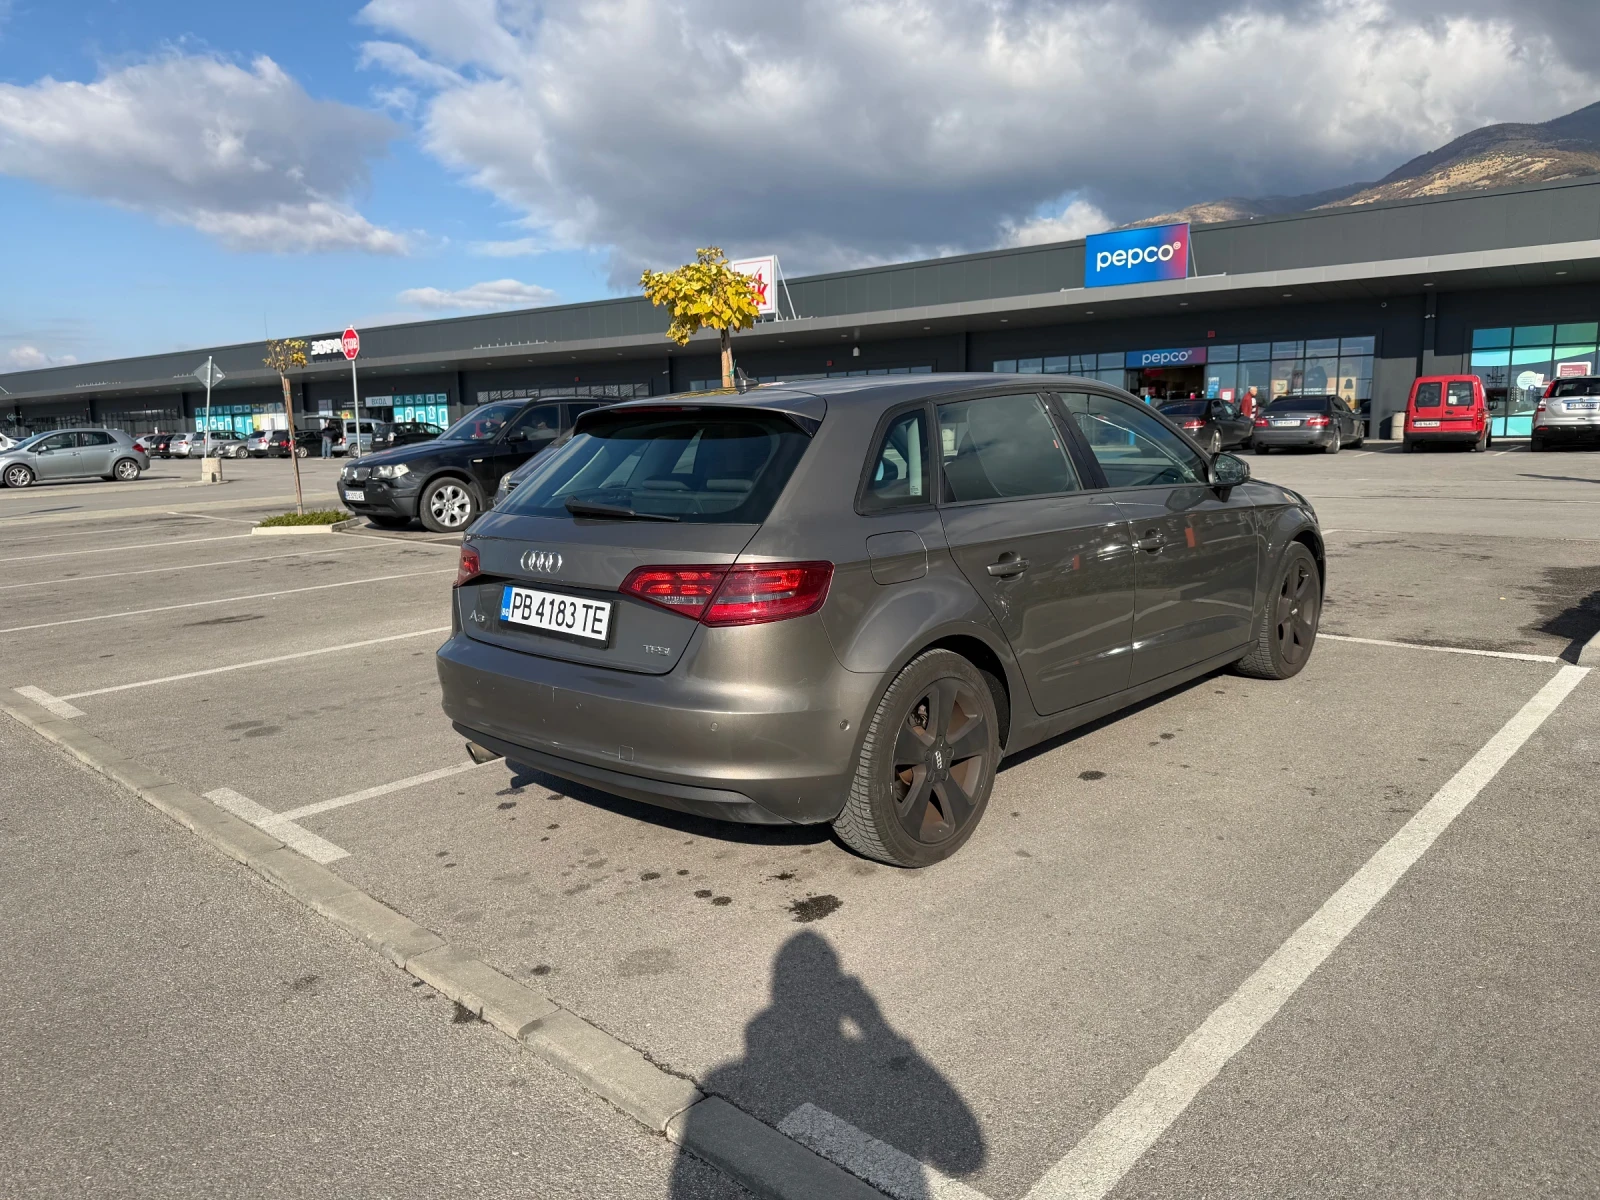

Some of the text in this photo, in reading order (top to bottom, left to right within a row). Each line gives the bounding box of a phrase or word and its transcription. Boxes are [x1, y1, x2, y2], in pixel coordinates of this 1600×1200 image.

[1096, 244, 1174, 272] pepco
[344, 338, 358, 353] STOP
[1142, 352, 1188, 365] pepco
[469, 609, 486, 623] A3
[535, 597, 577, 629] 4183
